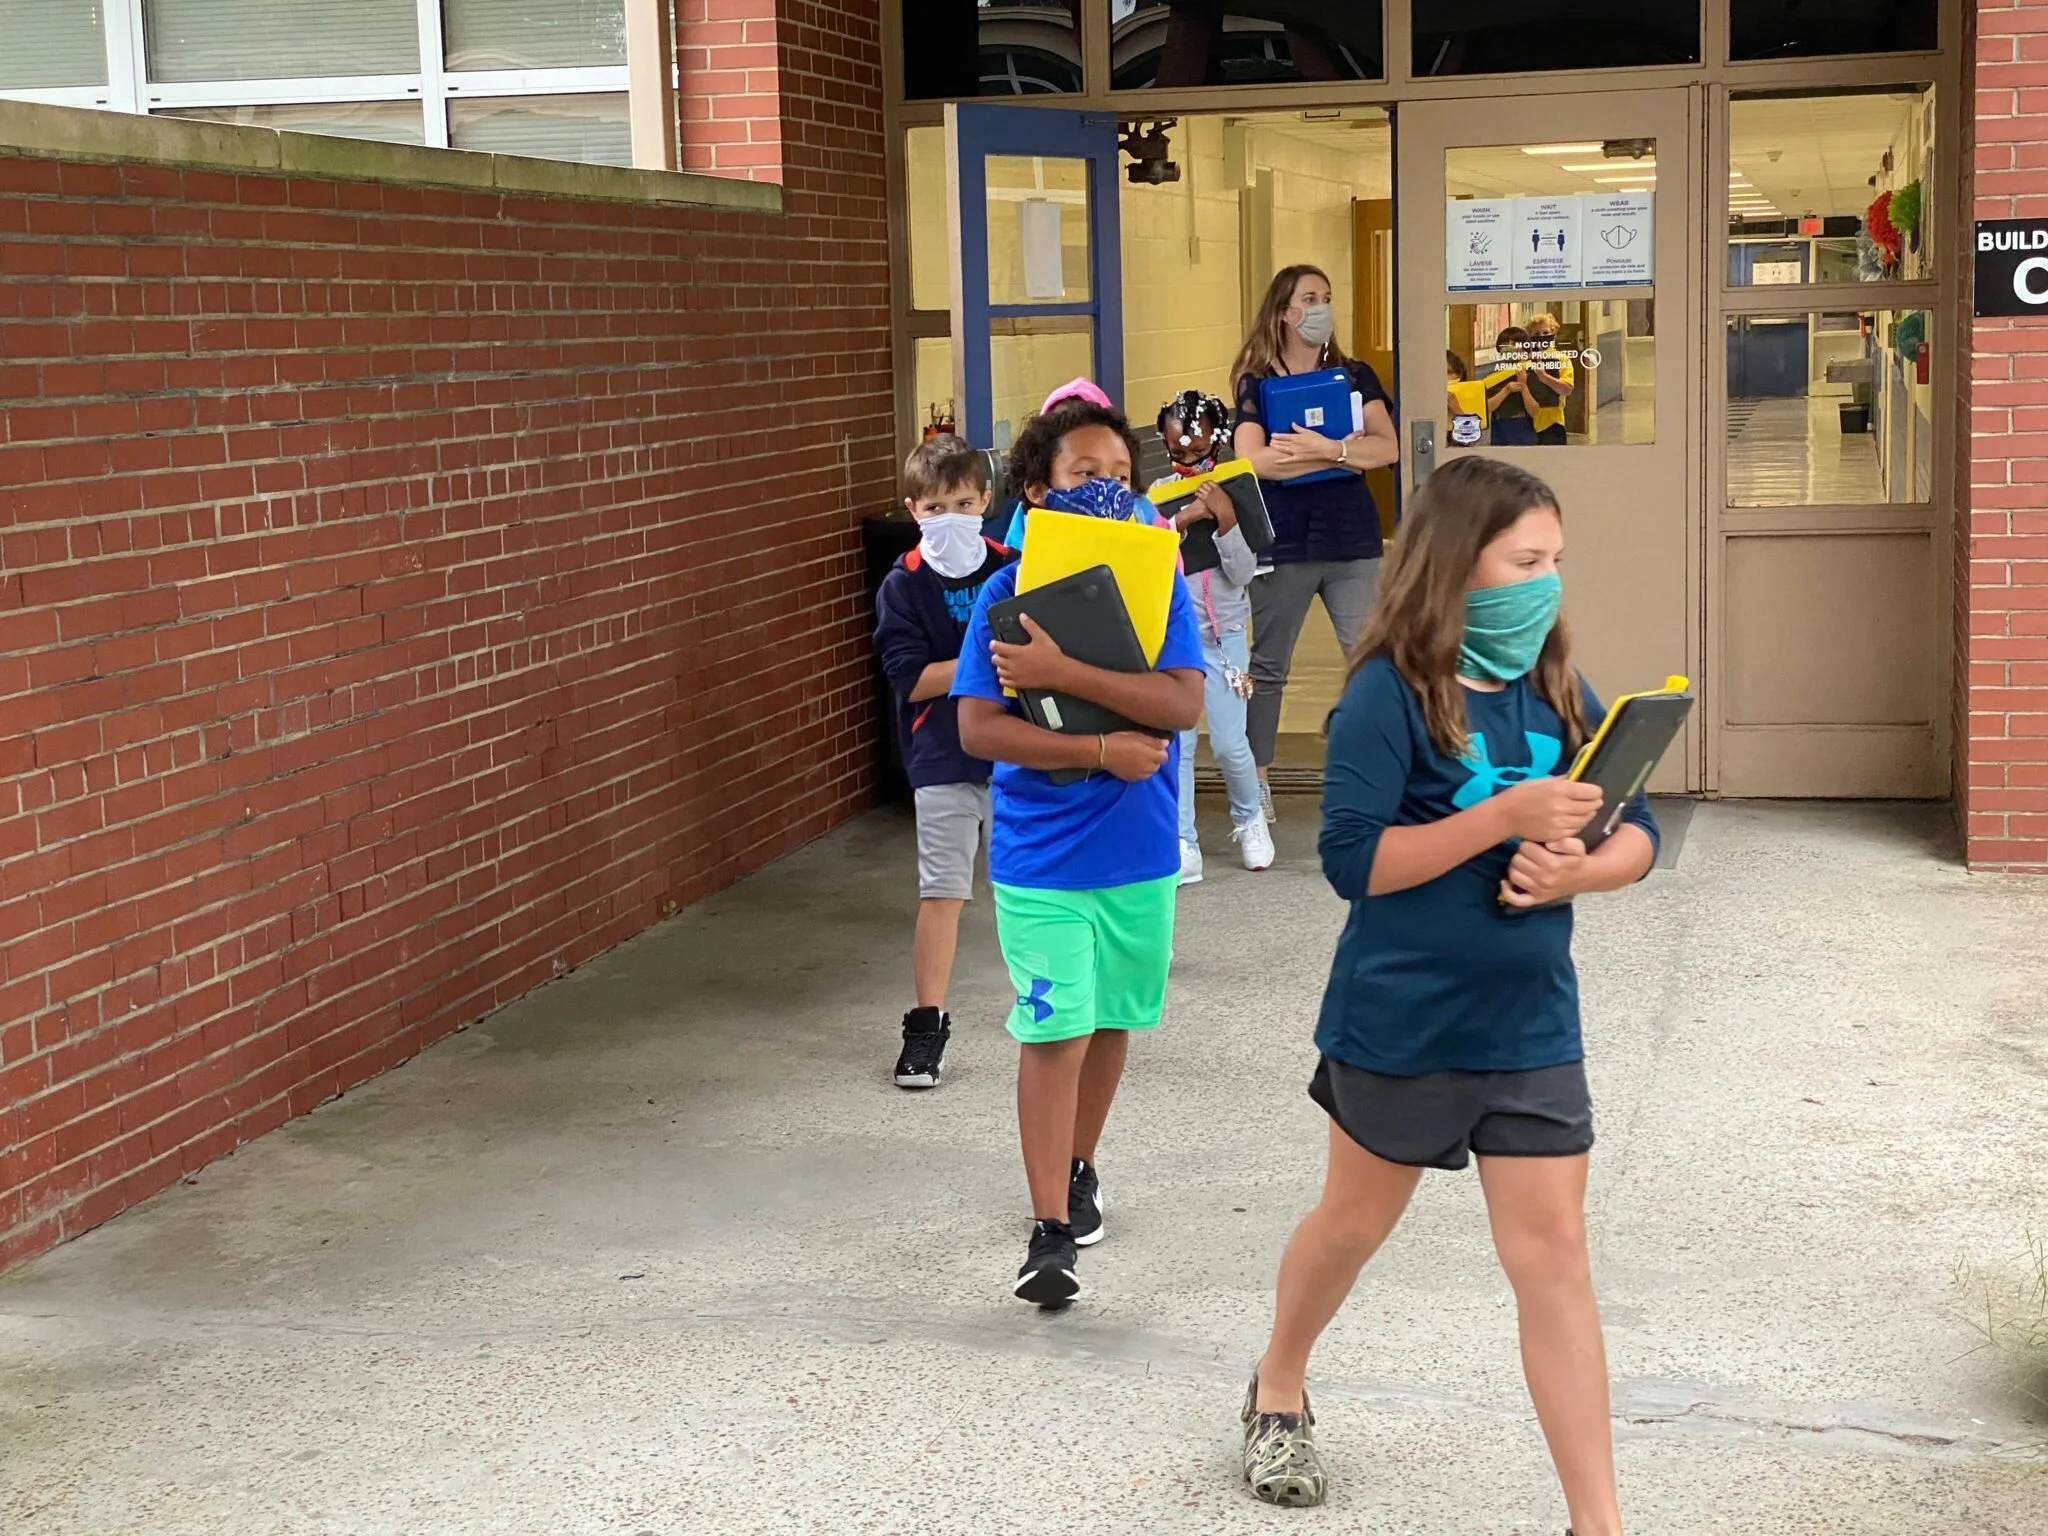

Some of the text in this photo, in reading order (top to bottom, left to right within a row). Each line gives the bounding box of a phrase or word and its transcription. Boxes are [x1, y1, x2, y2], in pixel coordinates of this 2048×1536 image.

[1978, 230, 2048, 251] BUILD
[2013, 256, 2048, 304] C
[1515, 340, 1556, 349] NOTICE
[1489, 350, 1579, 361] WEAPONS PROHIBITED
[1494, 360, 1573, 371] ARMAS PROHIBIDAS
